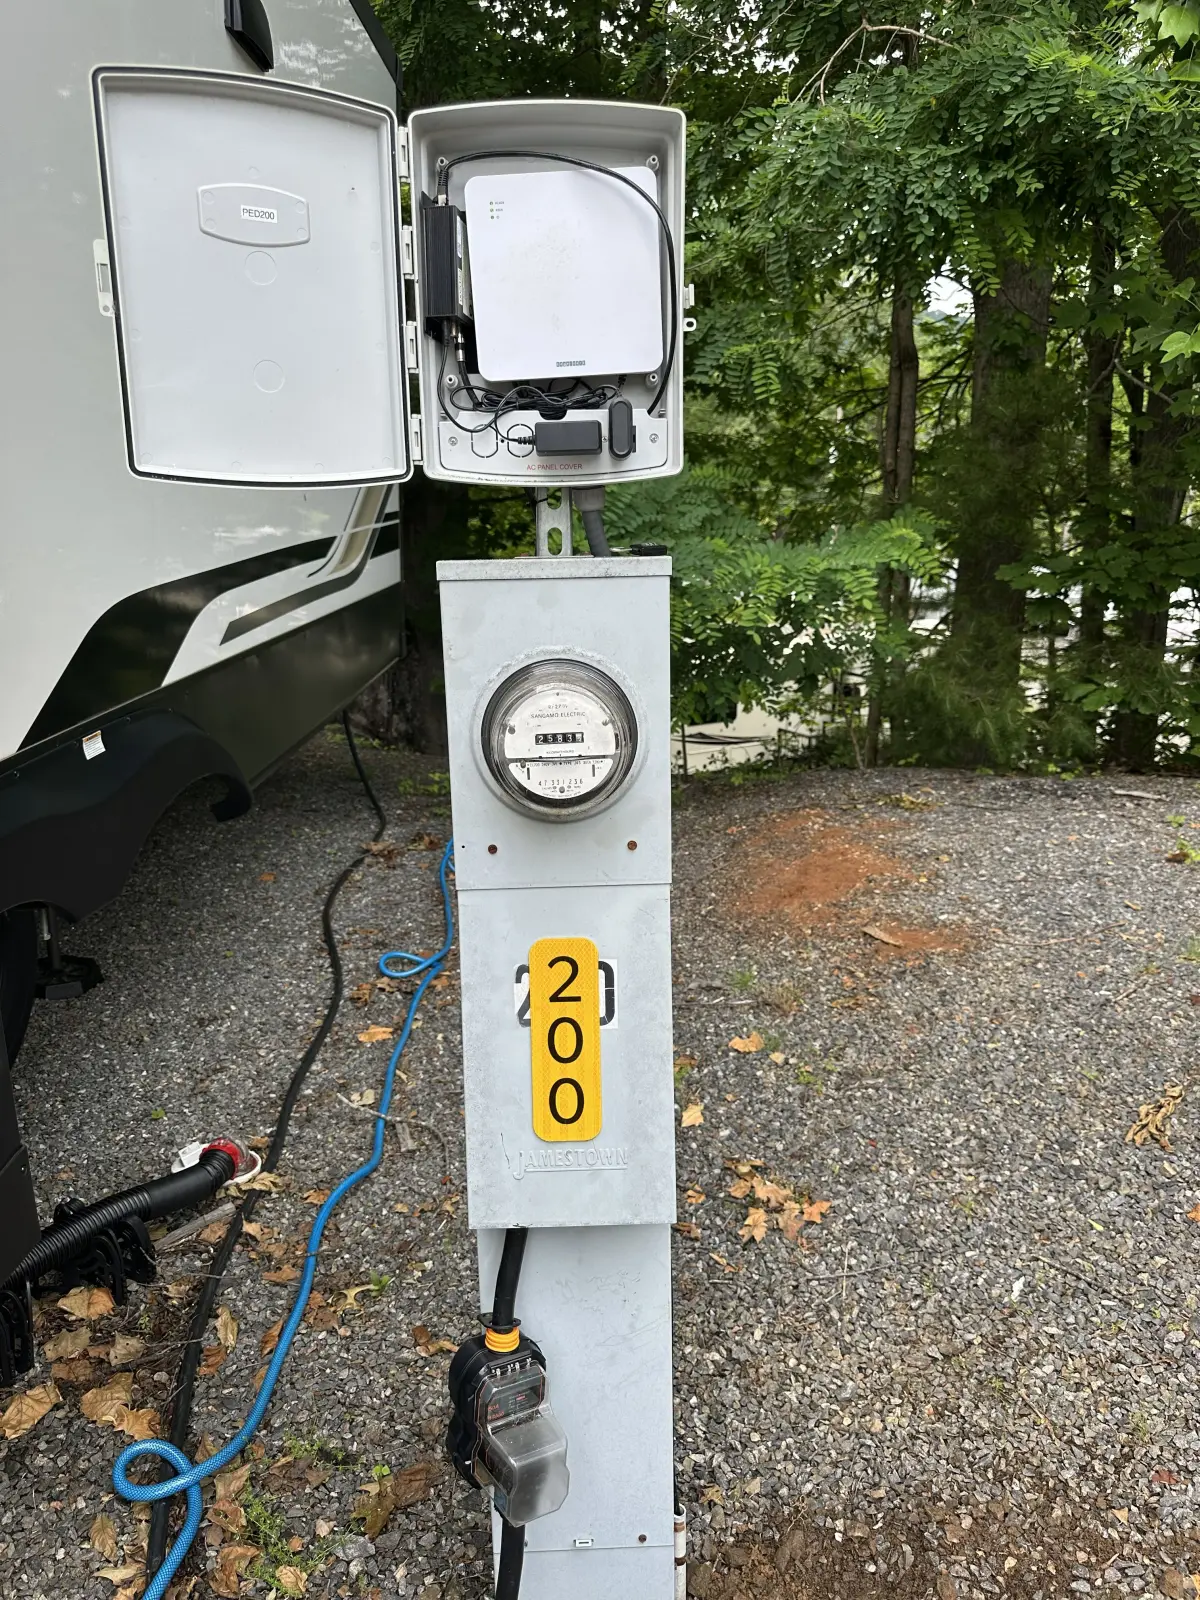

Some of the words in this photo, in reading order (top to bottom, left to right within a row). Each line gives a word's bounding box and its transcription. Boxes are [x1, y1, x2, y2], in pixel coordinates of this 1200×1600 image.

[242, 208, 275, 220] PED200
[547, 955, 585, 1125] 200
[513, 1147, 628, 1180] JAMESTOWN
